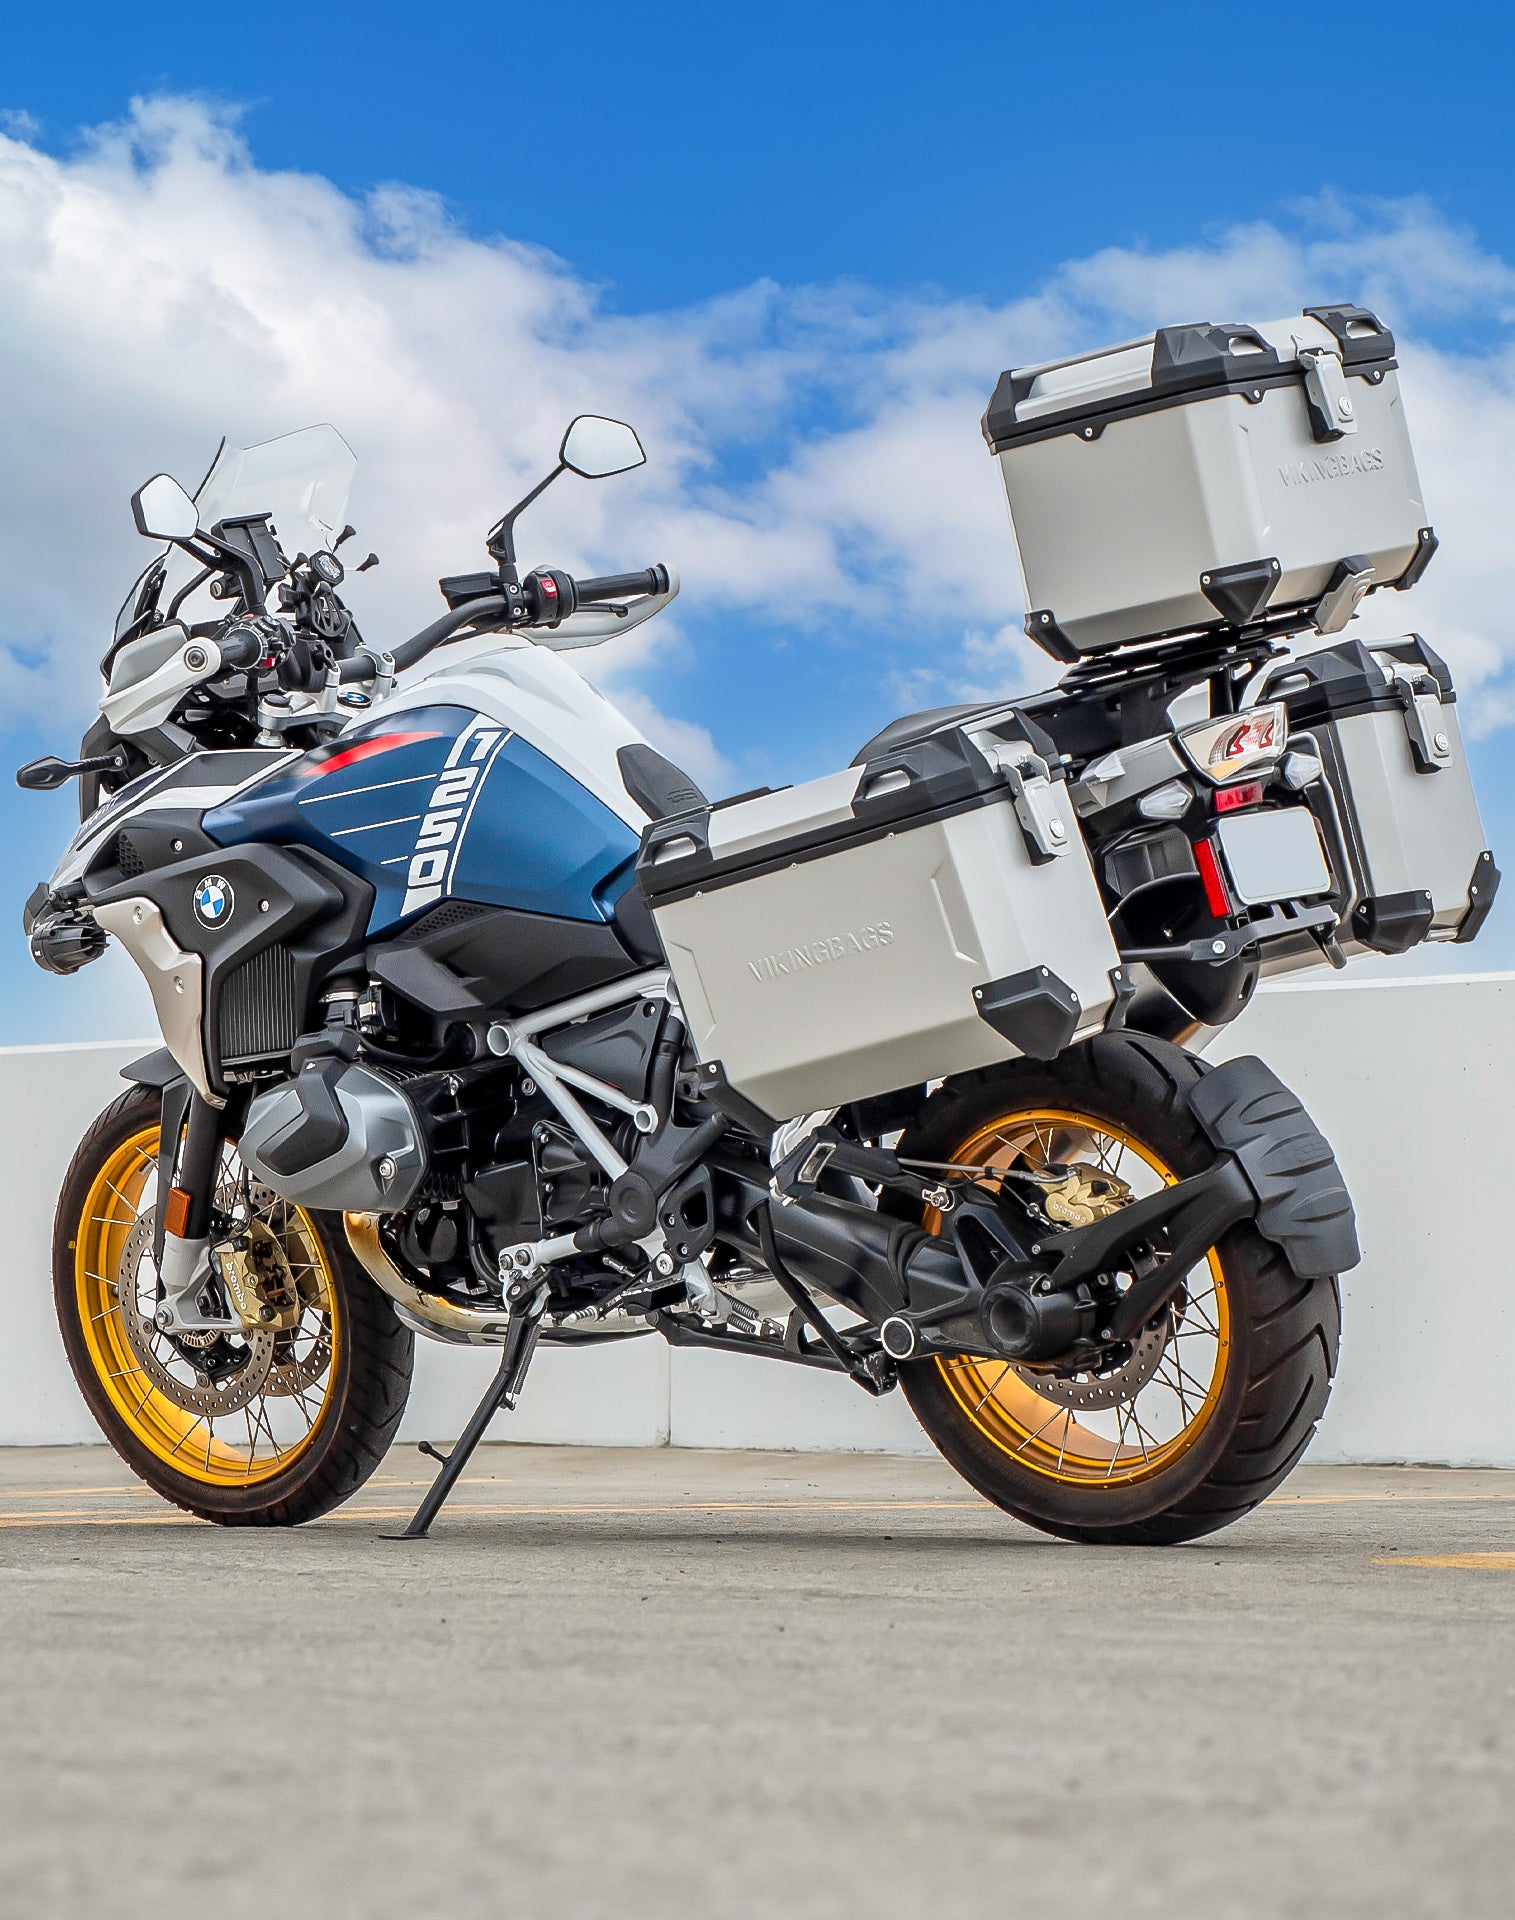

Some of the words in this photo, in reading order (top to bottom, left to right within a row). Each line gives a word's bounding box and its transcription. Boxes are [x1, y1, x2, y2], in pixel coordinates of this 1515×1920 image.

[1277, 447, 1384, 487] VIKINGBAGS
[407, 731, 502, 887] 1250
[195, 877, 227, 900] BMW
[747, 921, 896, 983] VIKINGBAGS
[225, 1261, 247, 1310] brembo
